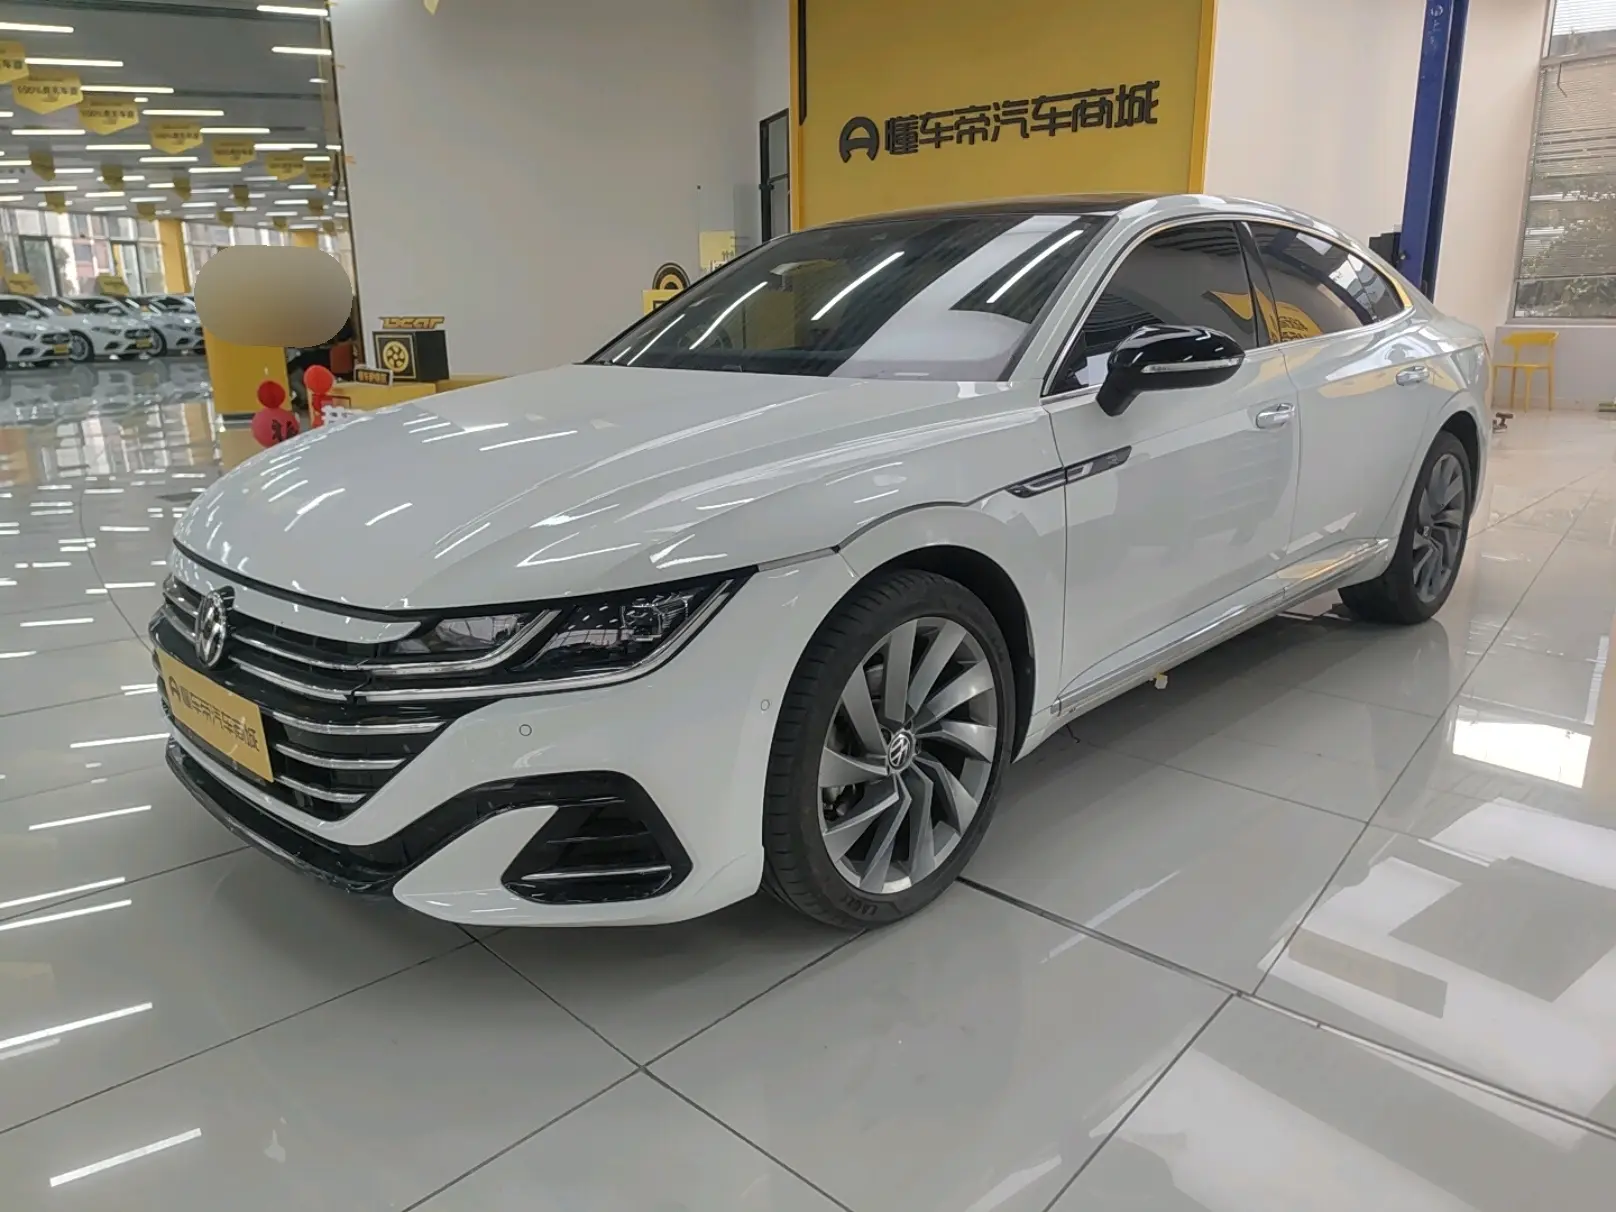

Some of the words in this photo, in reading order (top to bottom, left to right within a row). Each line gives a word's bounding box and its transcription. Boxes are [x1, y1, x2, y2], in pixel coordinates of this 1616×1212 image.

[885, 80, 1160, 155] 懂车帝汽车商城
